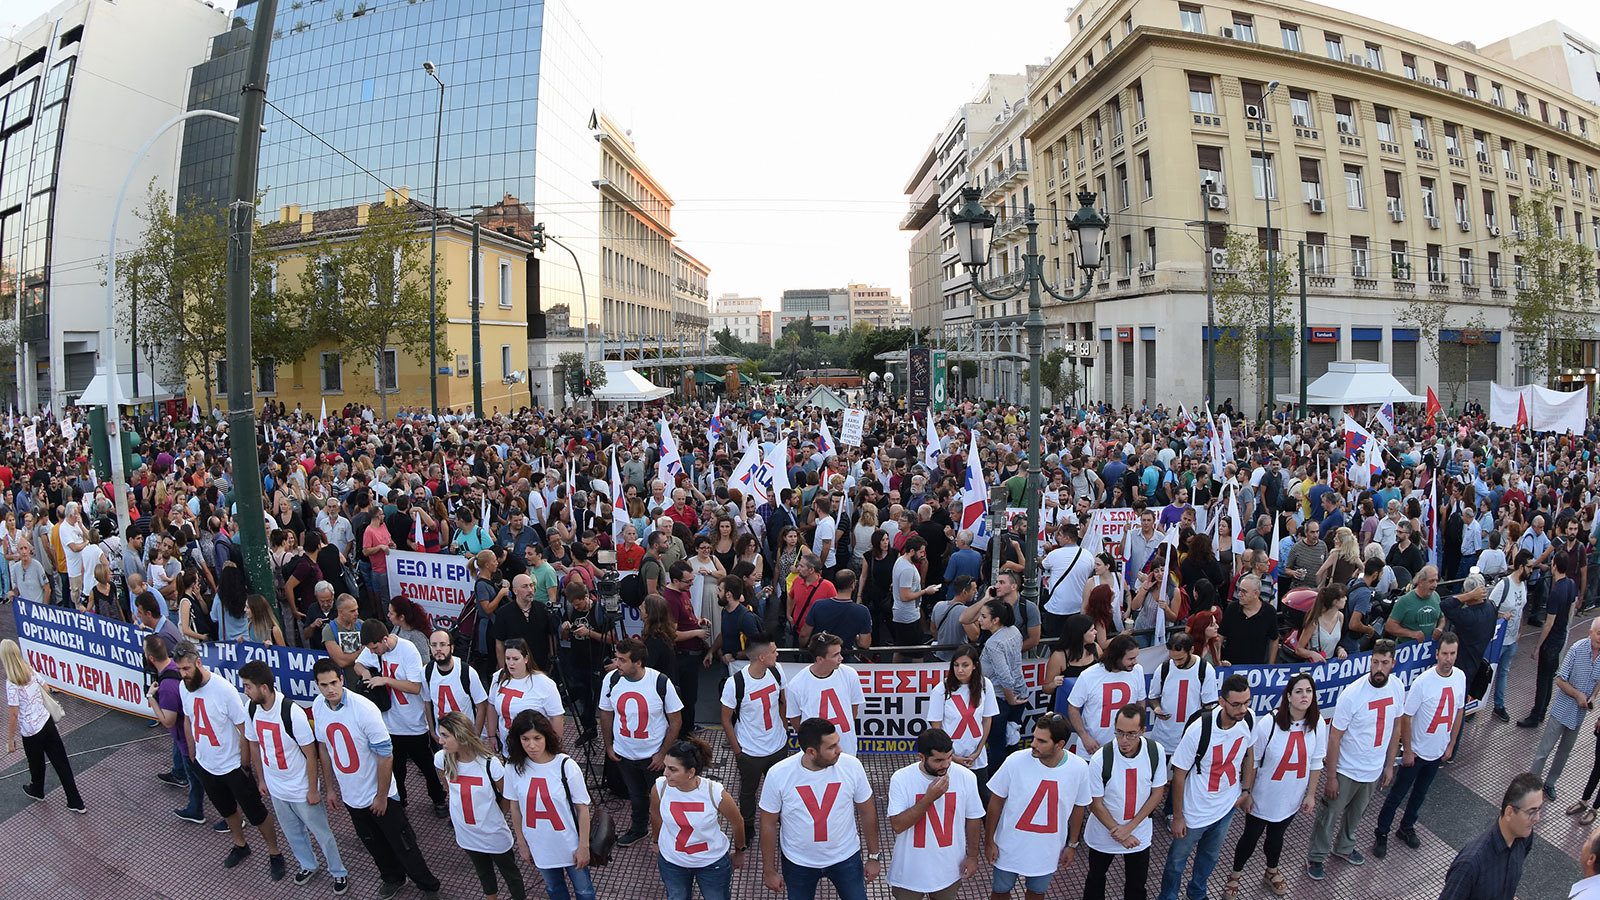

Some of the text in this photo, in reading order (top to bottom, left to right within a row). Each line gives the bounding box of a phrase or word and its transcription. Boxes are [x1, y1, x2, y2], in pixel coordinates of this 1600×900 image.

[397, 559, 427, 577] ΕΞΩ
[432, 562, 441, 579] Η
[400, 582, 467, 606] ΣΩΜΑΤΕΙΑ
[18, 601, 27, 615] Η
[31, 605, 95, 632] ΑΝΑΠΤΥΞΗ
[99, 620, 131, 643] ΤΟΥΣ
[22, 621, 144, 669] ΟΡΓΑΝΩΣΗ ΚΑΙ ΑΓΩΝ
[27, 649, 58, 679] ΚΑΤΩ
[60, 661, 74, 685] ΤΑ
[76, 663, 114, 697] ΧΕΡΙΑ
[118, 678, 142, 705] ΑΠΟ
[215, 643, 237, 662] ΤΗ
[288, 652, 329, 673] ΜΑ
[289, 678, 322, 697] ΜΑ
[438, 685, 462, 719] Α
[499, 687, 524, 730] Τ
[750, 684, 776, 731] Τ
[819, 688, 850, 734] Α
[1100, 682, 1131, 728] Ρ
[1427, 687, 1455, 734] Α
[193, 697, 221, 747] Α
[616, 692, 649, 739] Ω
[950, 694, 982, 739] Χ
[1368, 697, 1394, 748] Τ
[255, 720, 288, 769] Π
[326, 722, 360, 774] Ο
[858, 739, 916, 752] ΙΤΙΣΜΟΥ
[1207, 736, 1244, 792] Κ
[1271, 731, 1307, 781] Α
[450, 775, 483, 825] Τ
[526, 778, 565, 831] Α
[795, 782, 841, 842] Υ
[914, 792, 956, 849] Ν
[1015, 779, 1059, 834] Δ
[670, 801, 709, 854] Σ
